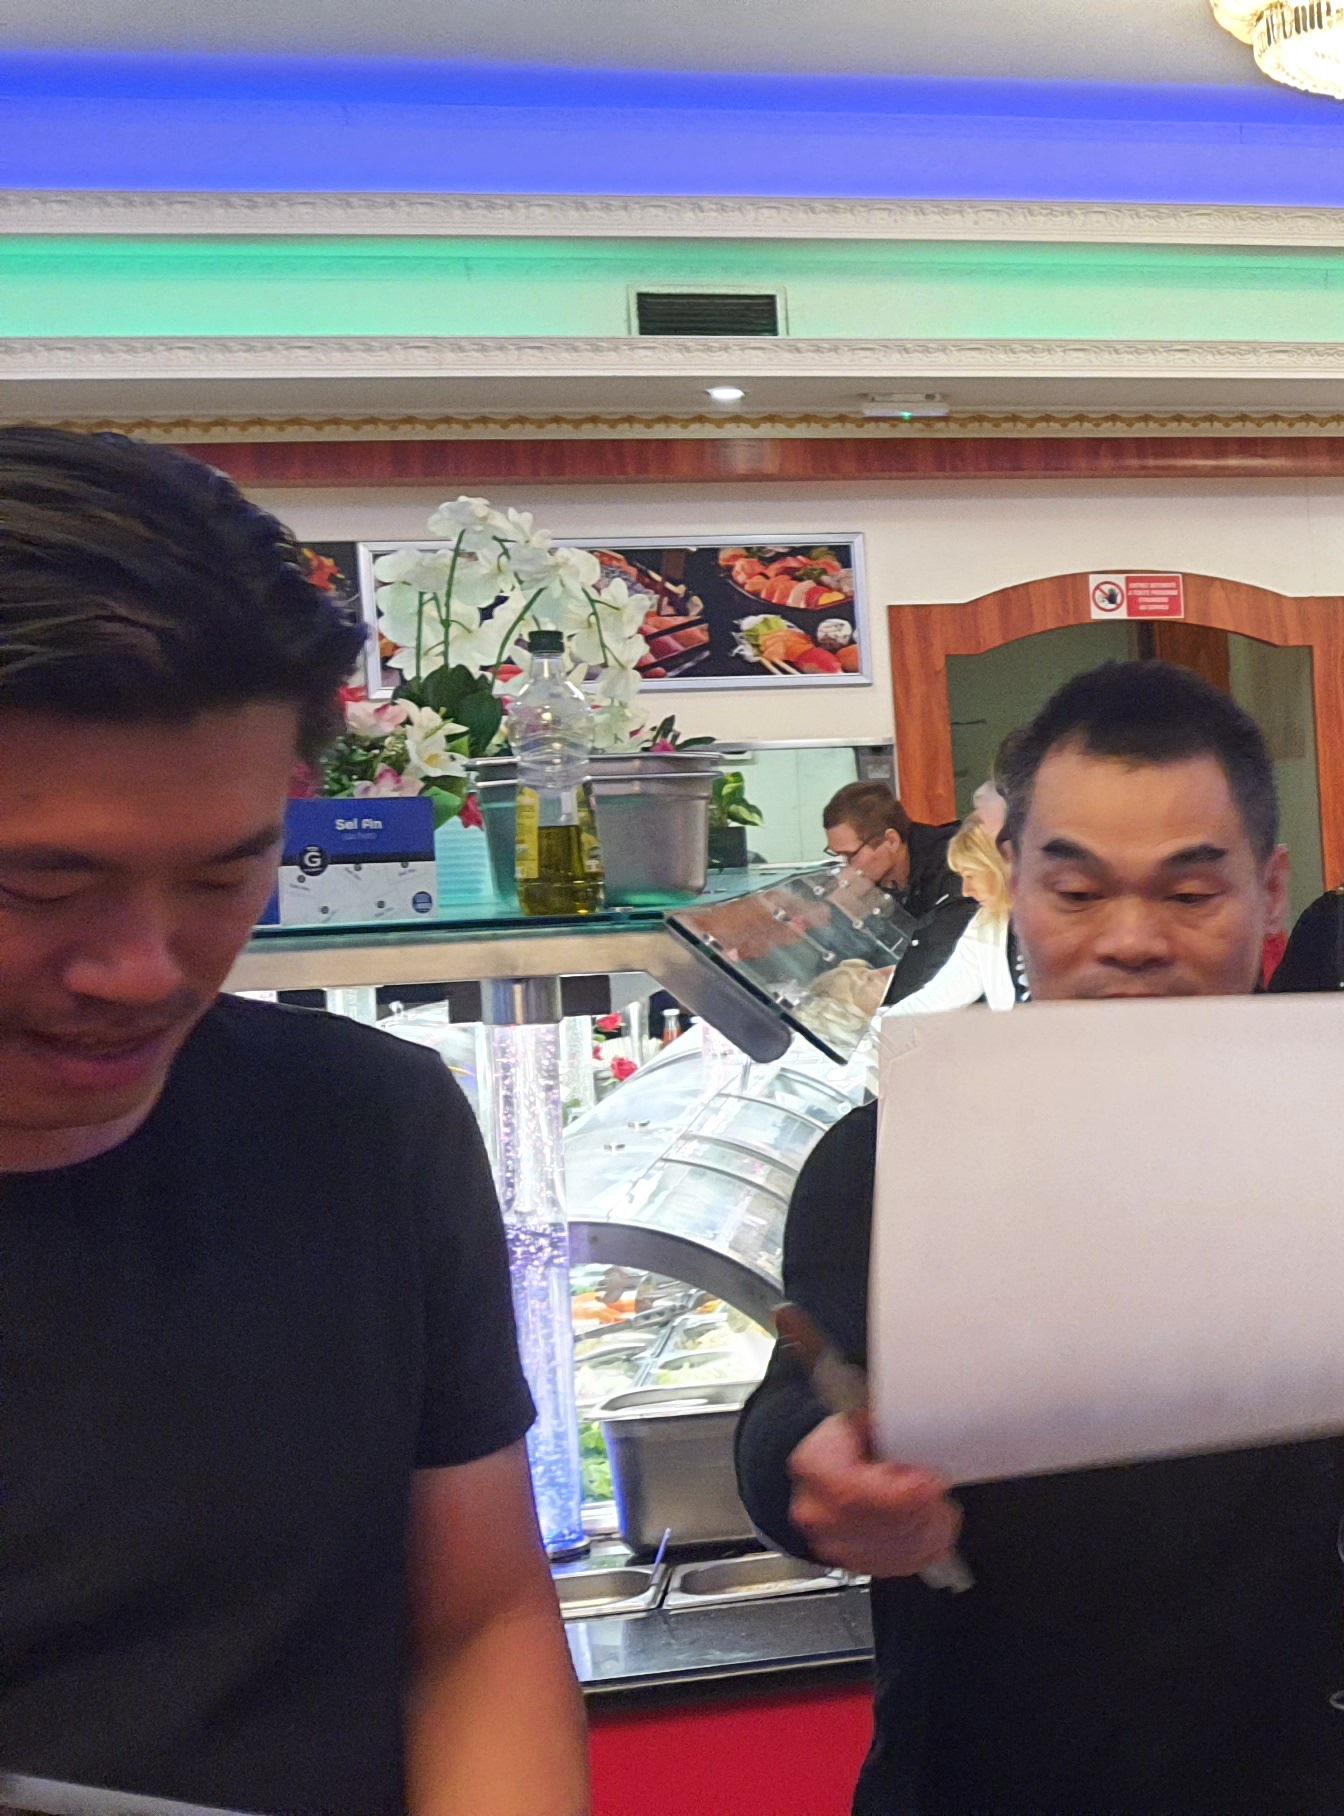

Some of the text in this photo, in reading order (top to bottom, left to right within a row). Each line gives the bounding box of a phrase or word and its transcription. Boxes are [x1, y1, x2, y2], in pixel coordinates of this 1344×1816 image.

[335, 818, 383, 831] Sel Fin
[303, 852, 322, 867] G
